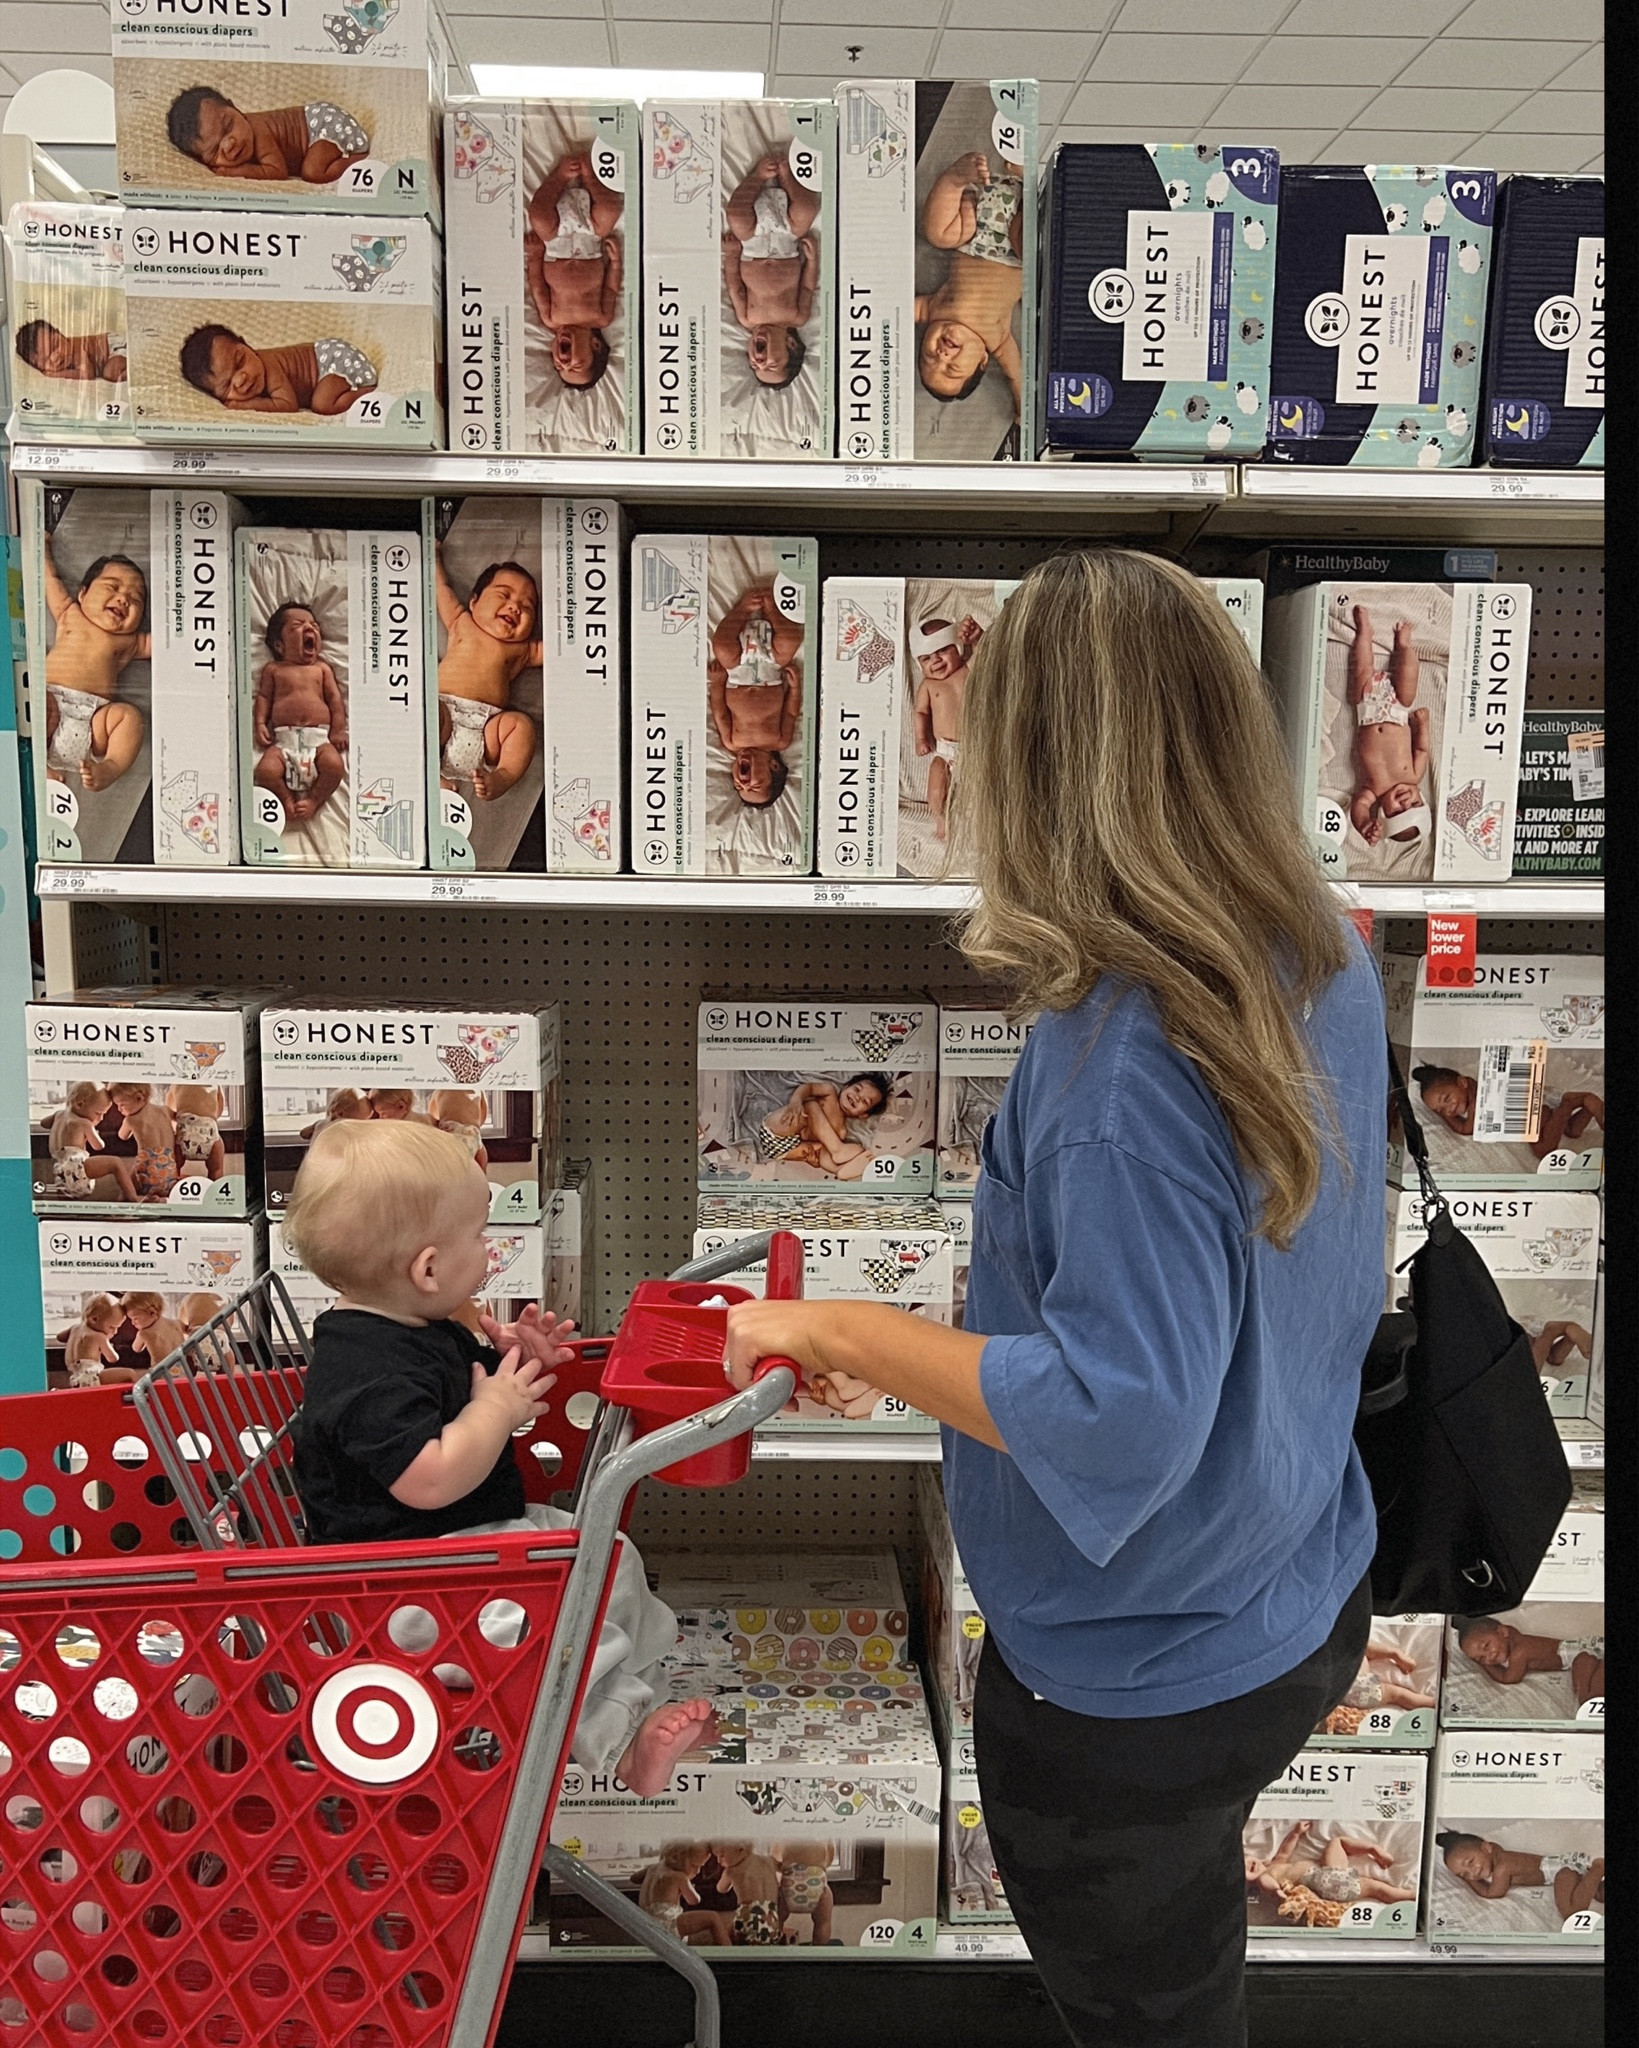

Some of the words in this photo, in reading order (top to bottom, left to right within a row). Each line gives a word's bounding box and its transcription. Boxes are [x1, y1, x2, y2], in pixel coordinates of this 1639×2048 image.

[121, 21, 150, 32] clean
[154, 23, 208, 34] conscious
[212, 24, 252, 39] diapers
[1000, 89, 1015, 100] 2
[999, 127, 1014, 149] 76
[598, 152, 615, 180] 80
[797, 152, 812, 178] 80
[1230, 158, 1261, 178] 3
[352, 169, 373, 186] 76
[398, 169, 413, 188] N
[1452, 181, 1480, 200] 3
[45, 223, 122, 240] HONEST
[169, 231, 300, 257] HONEST
[134, 262, 162, 272] clean
[167, 264, 220, 274] conscious
[224, 264, 263, 279] diapers
[1143, 226, 1168, 367] HONEST
[1174, 273, 1183, 321] overnights
[1356, 250, 1385, 390] HONEST
[462, 283, 483, 414] HONEST
[491, 323, 502, 362] diapers
[659, 283, 679, 413] HONEST
[687, 322, 698, 361] diapers
[880, 325, 892, 366] diapers
[850, 285, 871, 421] HONEST
[492, 366, 501, 418] conscious
[880, 370, 889, 425] conscious
[107, 404, 120, 415] 32
[361, 401, 381, 417] 76
[406, 400, 420, 418] N
[492, 422, 501, 450] clean
[688, 422, 696, 450] clean
[880, 430, 889, 458] clean
[29, 456, 59, 464] 12.99
[173, 459, 207, 468] 29.99
[487, 468, 518, 476] 29.99
[173, 499, 184, 530] clean
[564, 506, 576, 536] clean
[175, 534, 184, 588] conscious
[371, 545, 380, 572] clean
[567, 540, 576, 594] conscious
[1296, 556, 1390, 573] HealthyBaby
[194, 539, 215, 672] HONEST
[372, 576, 380, 627] conscious
[779, 586, 796, 612] 80
[1226, 598, 1241, 607] 3
[1476, 594, 1486, 621] clean
[173, 592, 184, 632] diapers
[564, 599, 576, 639] diapers
[585, 545, 606, 679] HONEST
[370, 631, 380, 668] diapers
[389, 581, 408, 706] HONEST
[1472, 625, 1482, 676] conscious
[1468, 680, 1480, 717] diapers
[1484, 630, 1511, 754] HONEST
[675, 746, 685, 782] diapers
[866, 746, 878, 783] diapers
[1526, 752, 1555, 764] LET'S
[647, 708, 666, 831] HONEST
[838, 709, 859, 832] HONEST
[1519, 768, 1550, 781] ABY'S
[57, 794, 71, 814] 76
[263, 798, 279, 822] 80
[450, 802, 467, 823] 76
[1325, 810, 1340, 832] 68
[1525, 808, 1573, 822] EXPLORE
[57, 839, 71, 848] 2
[1524, 841, 1549, 854] AND
[1552, 842, 1582, 854] MORE
[1584, 841, 1599, 854] AT
[451, 848, 465, 857] 2
[1323, 854, 1338, 863] 3
[1514, 857, 1601, 870] ALTHYBABY.COM
[53, 879, 84, 889] 29.99
[432, 885, 464, 895] 29.99
[815, 893, 844, 901] 29.99
[1431, 920, 1458, 930] New
[1431, 932, 1465, 942] lower
[1431, 943, 1461, 956] price
[1474, 968, 1550, 983] ONEST
[1424, 990, 1446, 998] clean
[1449, 991, 1489, 999] conscious
[1492, 991, 1521, 1000] diapers
[736, 1011, 842, 1028] HONEST
[64, 1024, 170, 1043] HONEST
[308, 1023, 433, 1044] HONEST
[706, 1034, 730, 1043] clean
[778, 1035, 810, 1046] diapers
[34, 1047, 58, 1055] clean
[108, 1049, 141, 1060] diapers
[274, 1051, 301, 1060] clean
[306, 1052, 356, 1061] conscious
[360, 1052, 397, 1064] diapers
[945, 1046, 964, 1054] clean
[967, 1046, 1006, 1054] conscious
[875, 1160, 894, 1173] 50
[912, 1161, 921, 1174] 5
[1550, 1154, 1566, 1166] 36
[1583, 1155, 1591, 1167] 7
[180, 1182, 201, 1196] 60
[219, 1183, 230, 1196] 4
[511, 1189, 523, 1203] 4
[1474, 1224, 1504, 1233] diapers
[79, 1236, 182, 1253] HONEST
[804, 1239, 850, 1258] EST
[122, 1260, 154, 1270] diapers
[284, 1261, 308, 1271] clea
[1565, 1381, 1573, 1393] 7
[885, 1396, 907, 1411] 50
[1590, 1701, 1604, 1713] 72
[1370, 1715, 1390, 1728] 88
[1411, 1716, 1420, 1729] 6
[1476, 1753, 1562, 1766] HONEST
[1288, 1765, 1356, 1782] NEST
[1510, 1771, 1537, 1779] diapers
[591, 1774, 707, 1792] HOST
[1292, 1787, 1326, 1796] diapers
[560, 1798, 585, 1806] clean
[589, 1798, 636, 1806] conscious
[640, 1797, 675, 1808] diapers
[1352, 1908, 1372, 1920] 88
[1392, 1909, 1401, 1921] 6
[1575, 1915, 1590, 1926] 72
[868, 1925, 894, 1938] 120
[912, 1926, 922, 1939] 4
[956, 1944, 983, 1952] 49.99
[1430, 1945, 1457, 1953] 49.99
